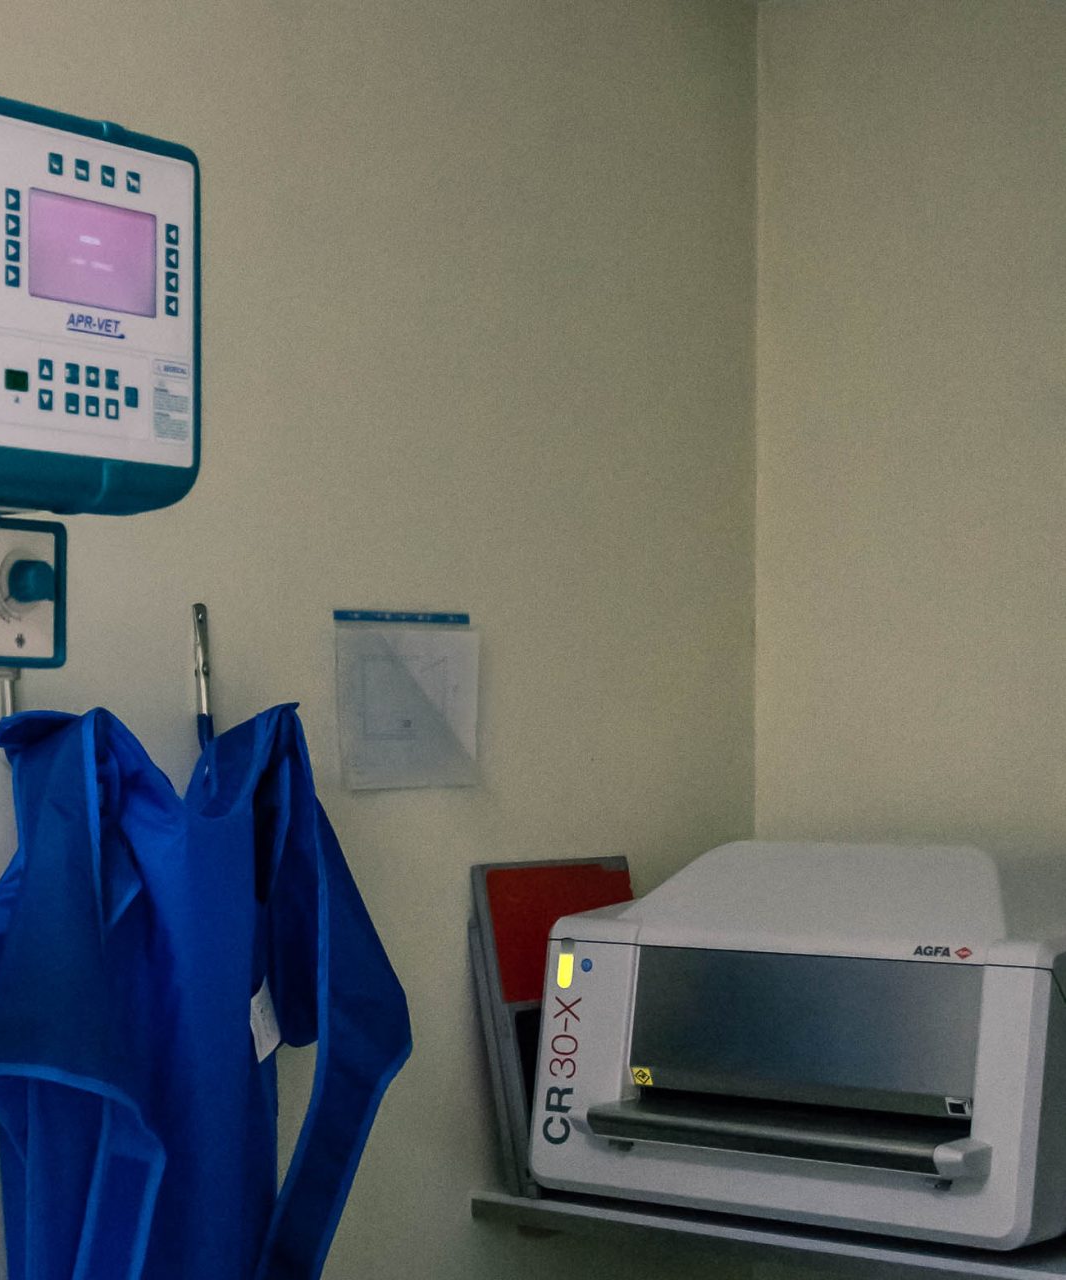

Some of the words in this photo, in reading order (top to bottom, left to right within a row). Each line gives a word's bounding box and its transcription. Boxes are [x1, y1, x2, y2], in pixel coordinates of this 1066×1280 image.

[67, 313, 121, 333] APR-VET
[913, 945, 951, 957] AGFA
[549, 996, 582, 1079] 30-X
[542, 1086, 574, 1145] CR
